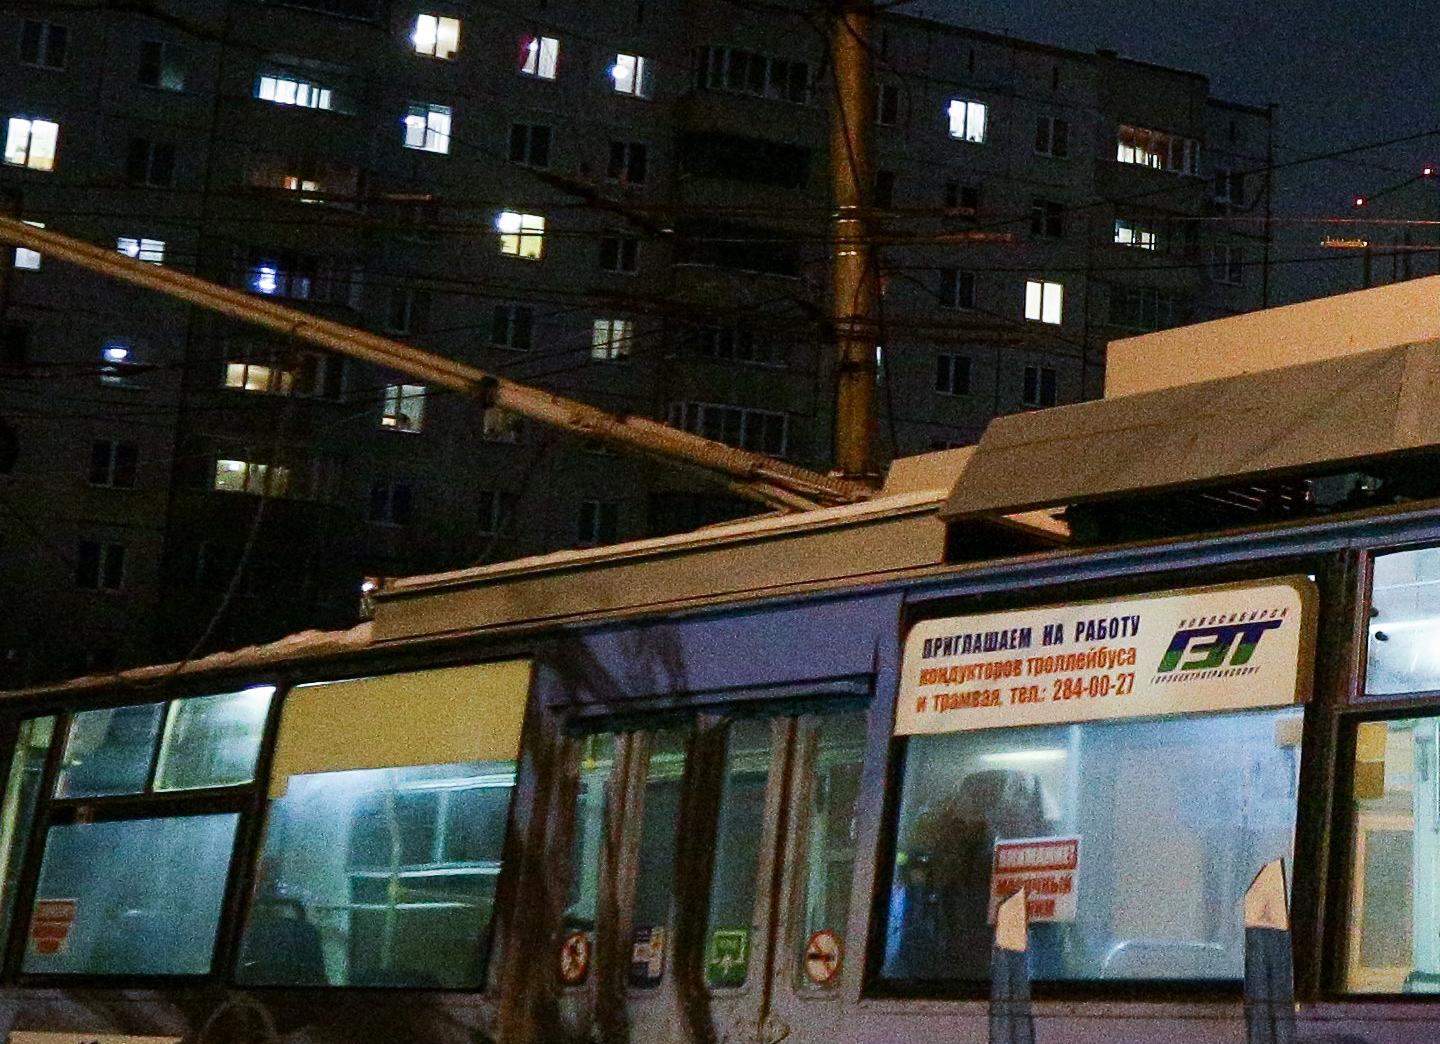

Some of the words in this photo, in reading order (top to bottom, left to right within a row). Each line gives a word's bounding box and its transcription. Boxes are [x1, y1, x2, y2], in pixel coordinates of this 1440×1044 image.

[921, 627, 1032, 659] ПРИГЛАШАЕМ
[1042, 623, 1064, 647] НА
[1074, 615, 1141, 643] РАБОТУ
[1178, 607, 1287, 628] НОВОСИБИРСК
[919, 658, 1022, 687] кондукторов
[1027, 646, 1137, 677] троллейбуса
[1157, 619, 1284, 673] ГЭТ
[916, 696, 927, 713] и
[1052, 672, 1136, 702] 284-00-27
